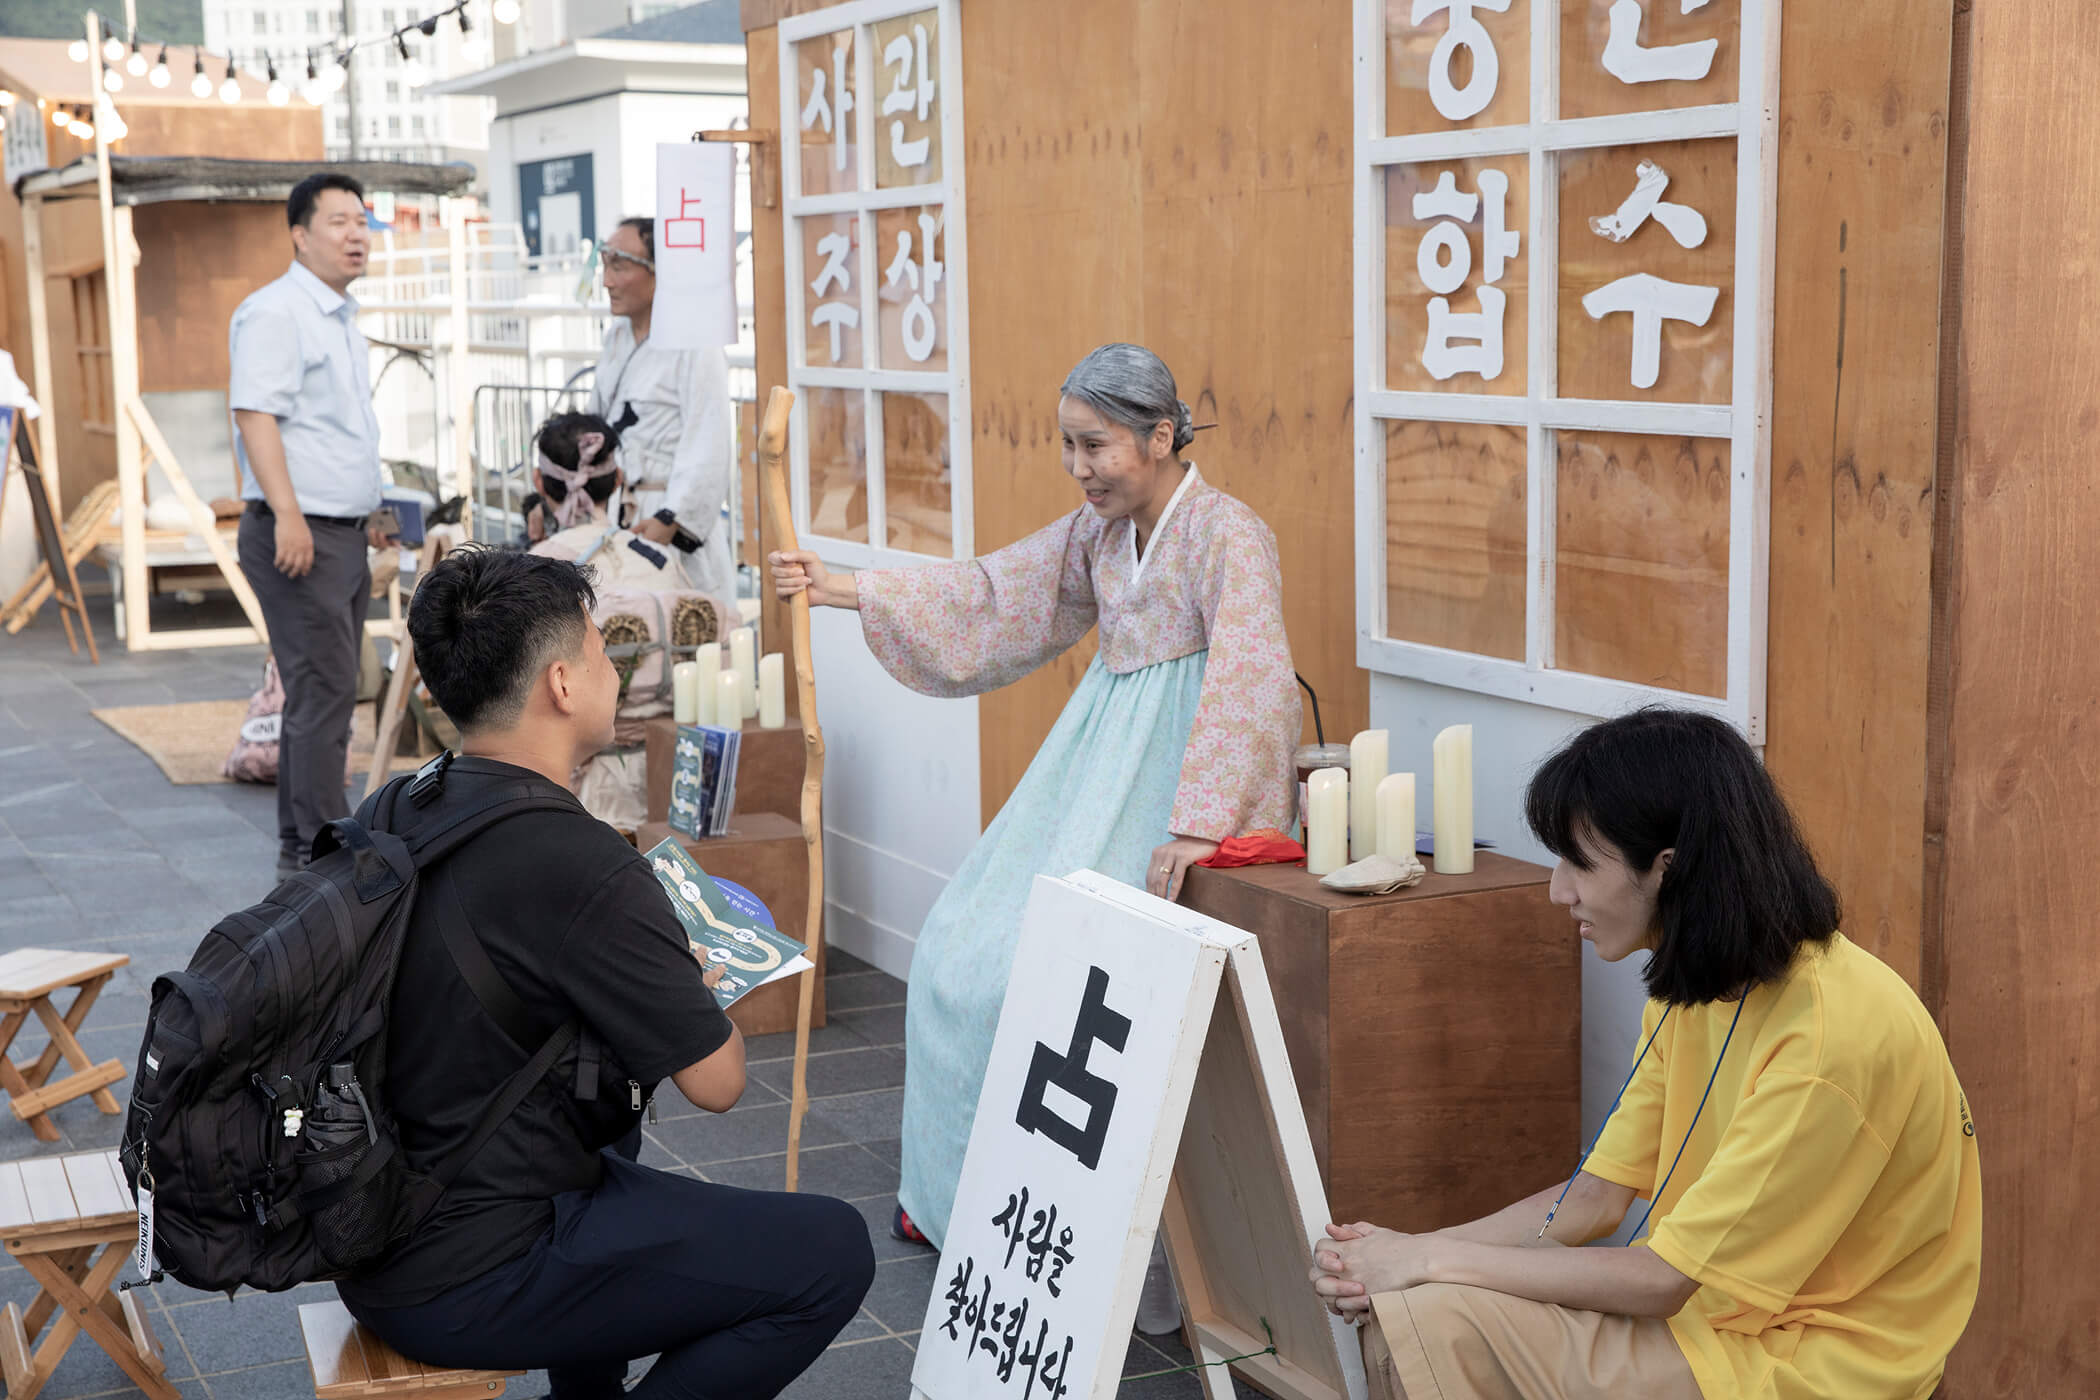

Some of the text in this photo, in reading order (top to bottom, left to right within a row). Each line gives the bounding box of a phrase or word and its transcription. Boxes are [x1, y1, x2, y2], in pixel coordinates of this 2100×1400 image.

[802, 47, 859, 363] 사주
[882, 23, 943, 362] 관상
[939, 1256, 1073, 1400] 찾아드립니다
[992, 1186, 1075, 1298] 사람을
